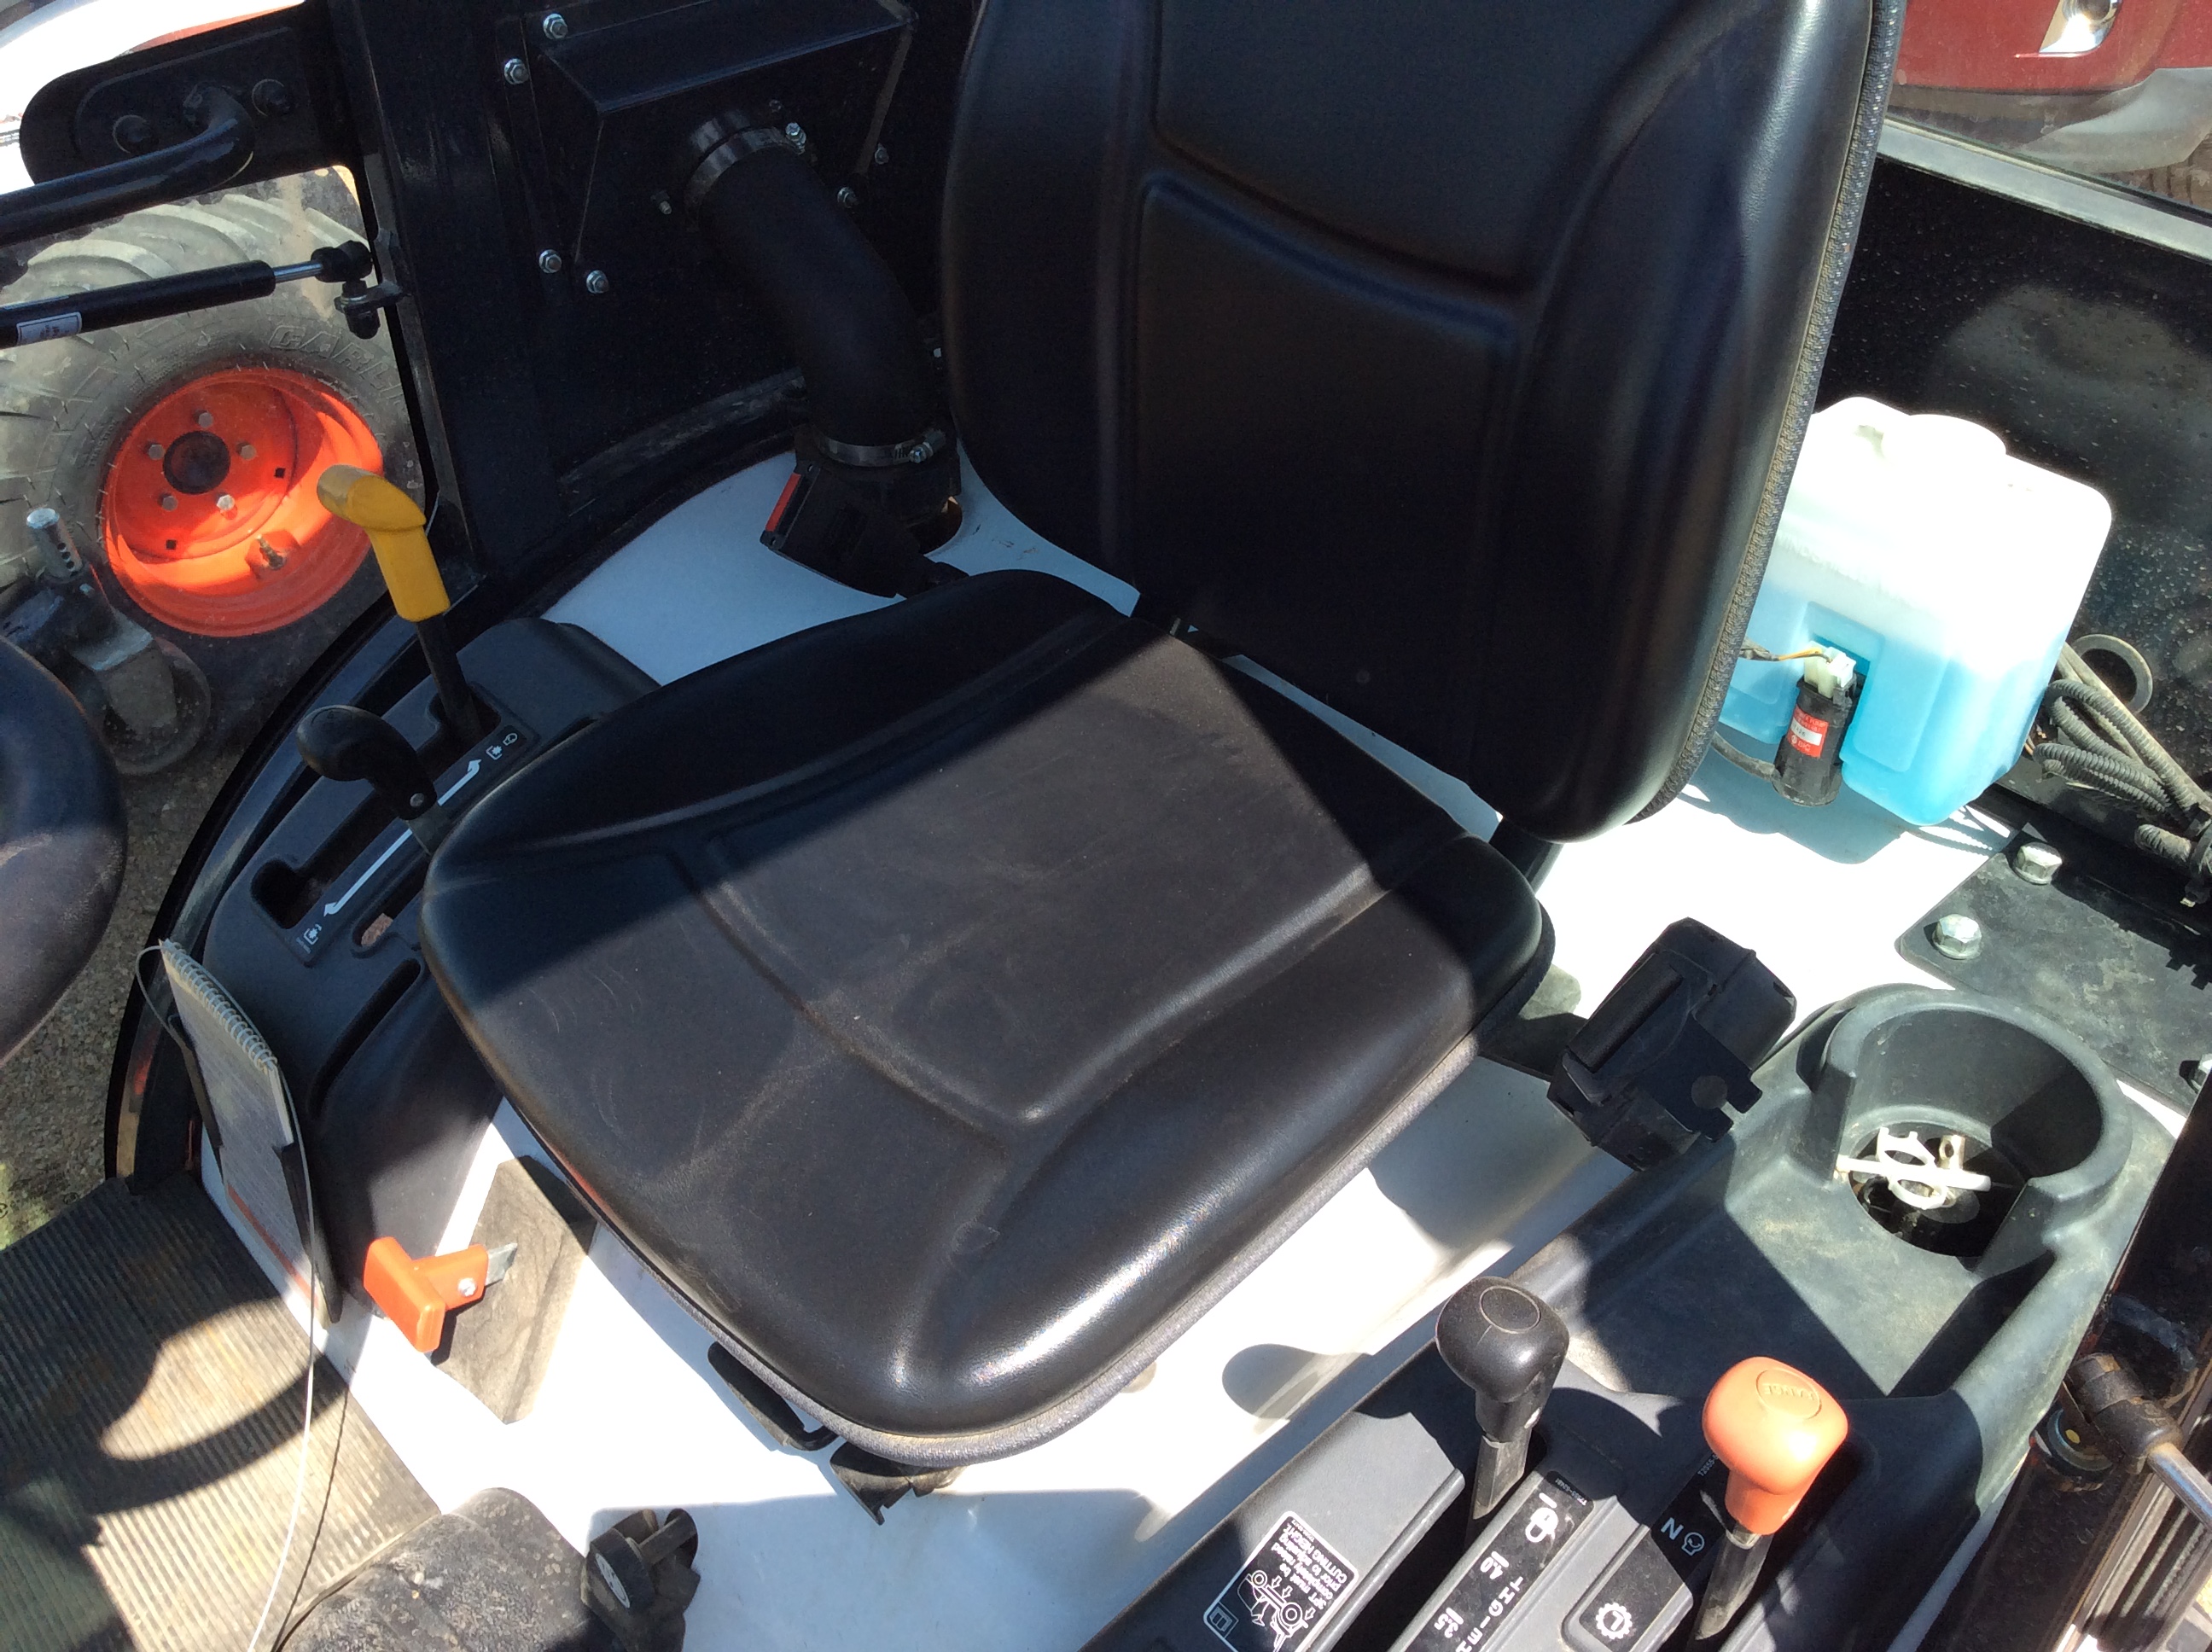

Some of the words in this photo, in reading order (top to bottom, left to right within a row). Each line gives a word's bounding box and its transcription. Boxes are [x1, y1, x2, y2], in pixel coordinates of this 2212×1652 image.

[1661, 1517, 1684, 1540] N
[1272, 1542, 1295, 1565] raised
[1278, 1533, 1313, 1566] adjusting
[1279, 1563, 1291, 1577] be
[1312, 1549, 1348, 1584] CUTTING
[1312, 1564, 1321, 1576] to
[1480, 1556, 1504, 1579] 4.0
[1290, 1573, 1311, 1593] must
[1294, 1562, 1333, 1599] completely
[1320, 1573, 1342, 1591] prior
[1434, 1613, 1458, 1638] 3.5
[1455, 1576, 1524, 1652] HEIGHT
